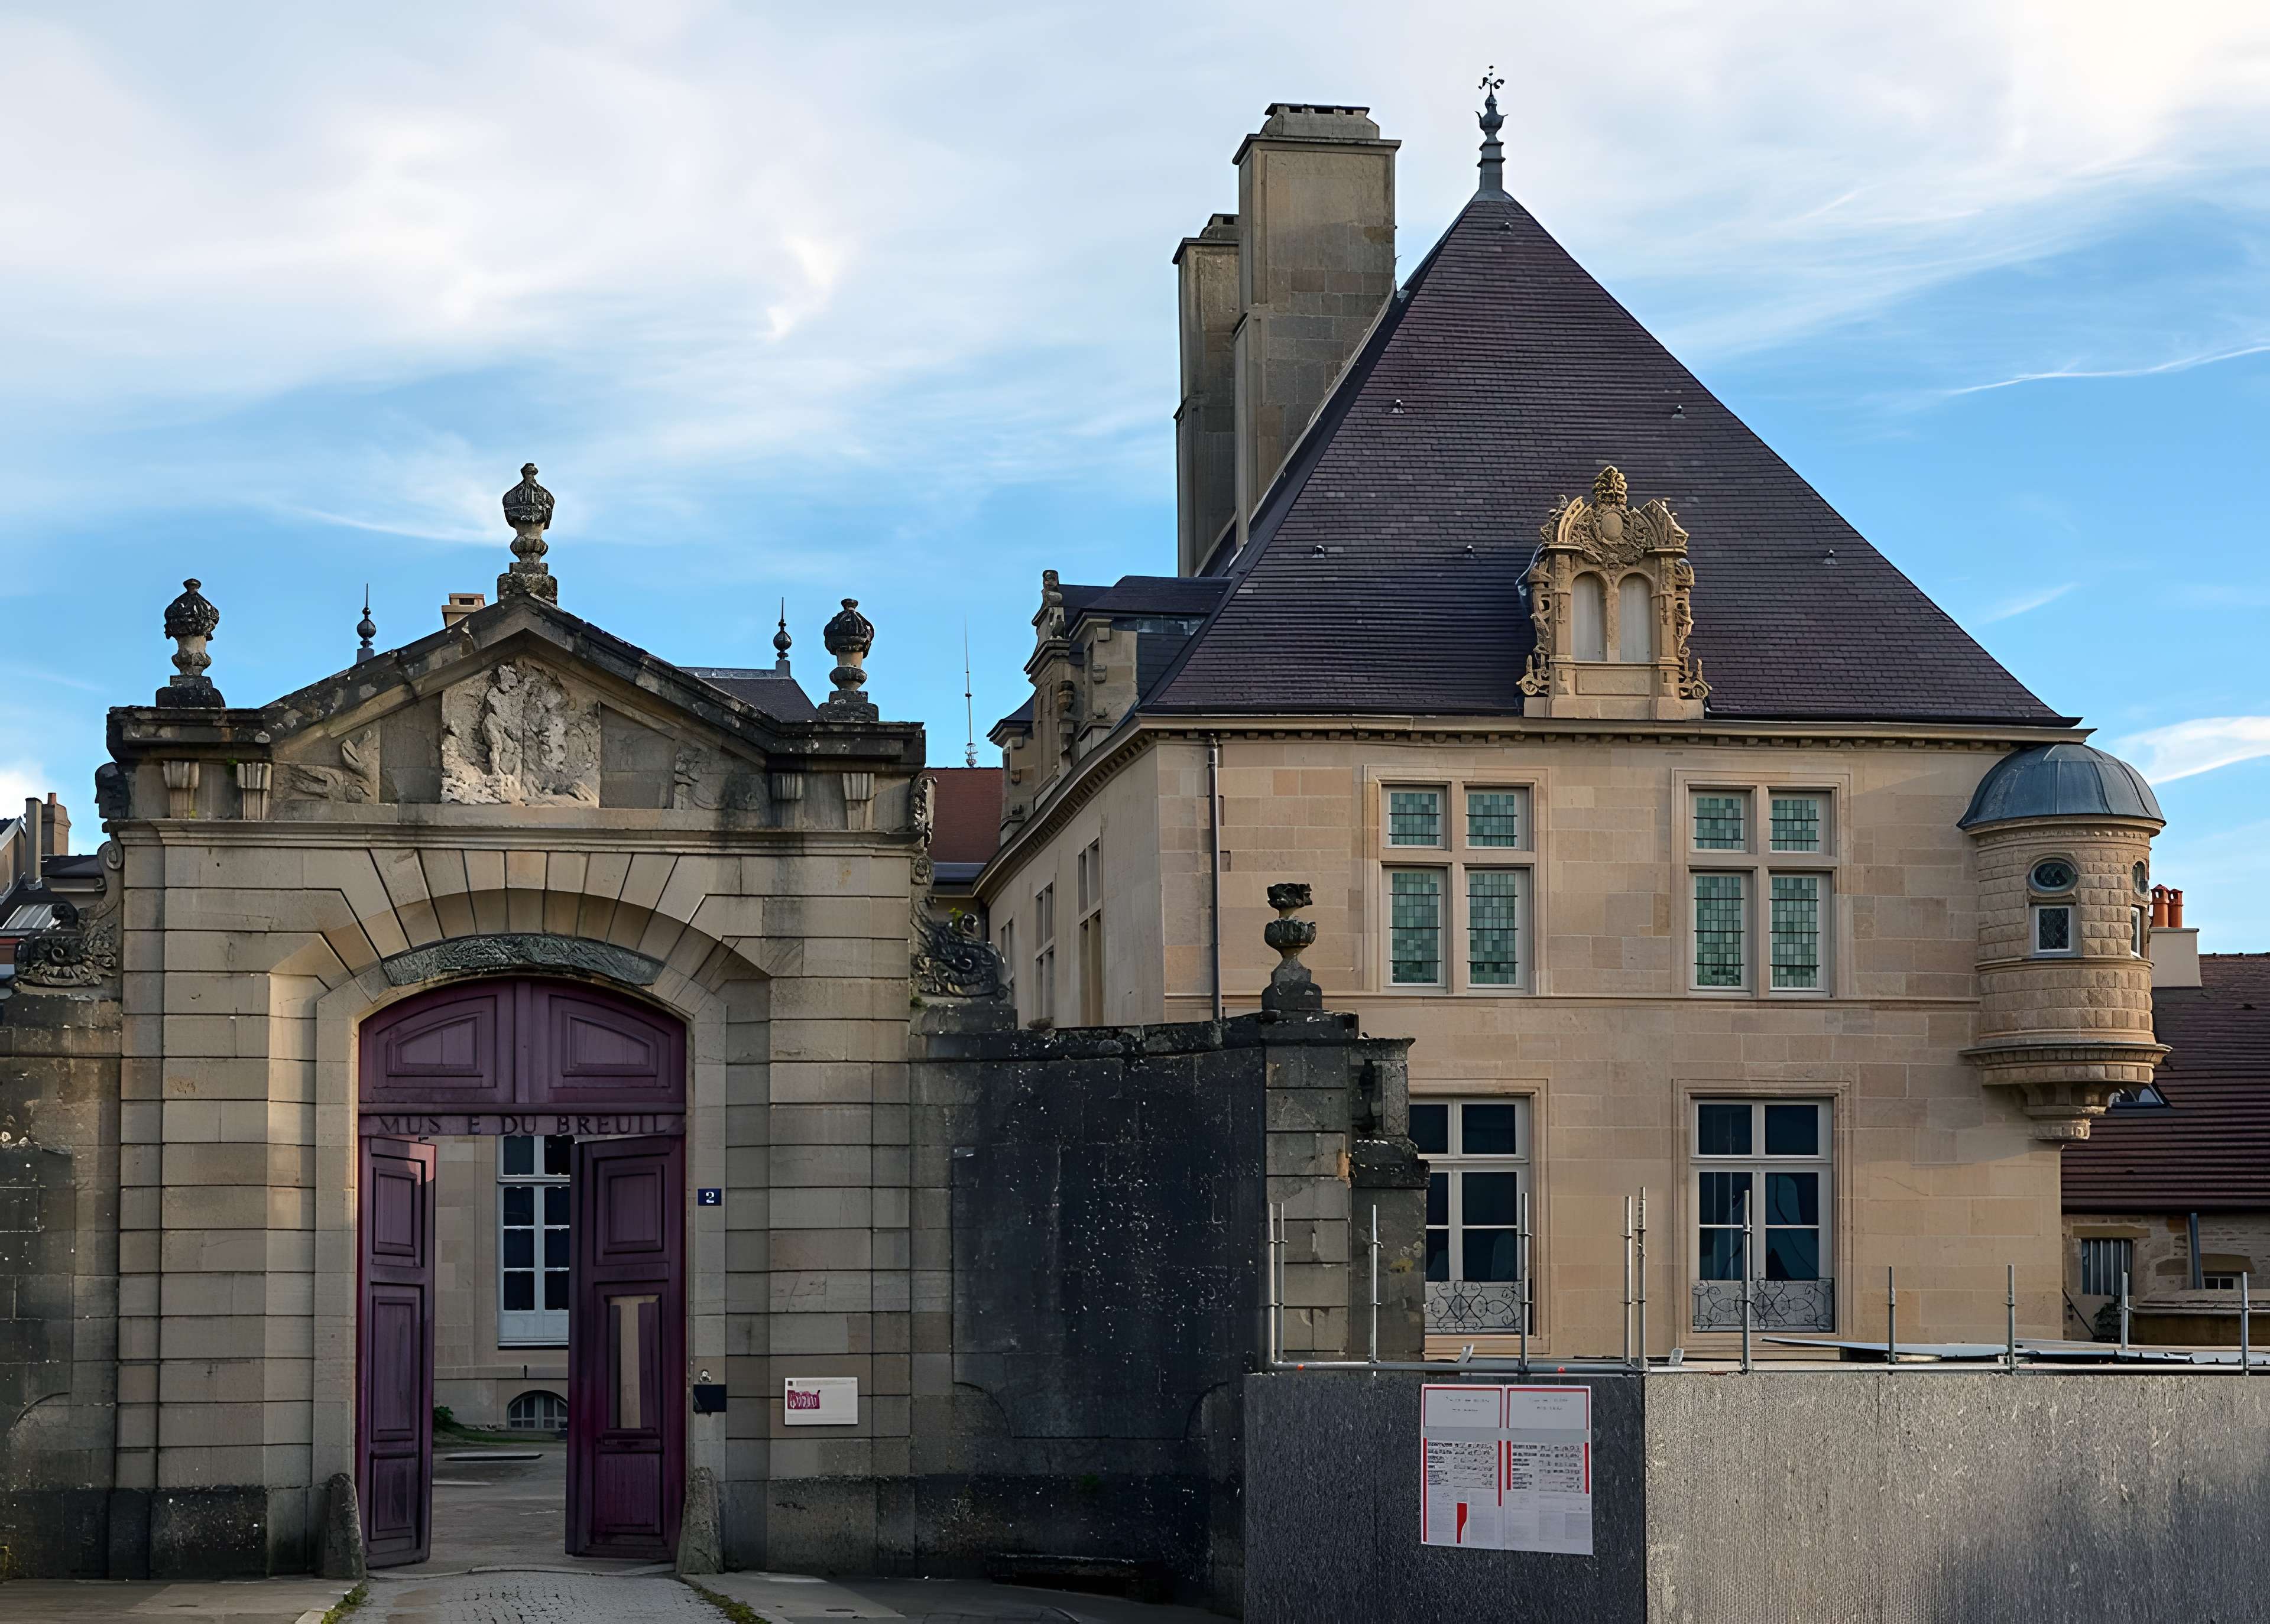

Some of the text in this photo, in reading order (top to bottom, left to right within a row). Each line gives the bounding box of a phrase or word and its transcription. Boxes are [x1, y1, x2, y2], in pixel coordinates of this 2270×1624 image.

[377, 1115, 667, 1135] MUSE DU BREUIL
[706, 1191, 715, 1203] 2
